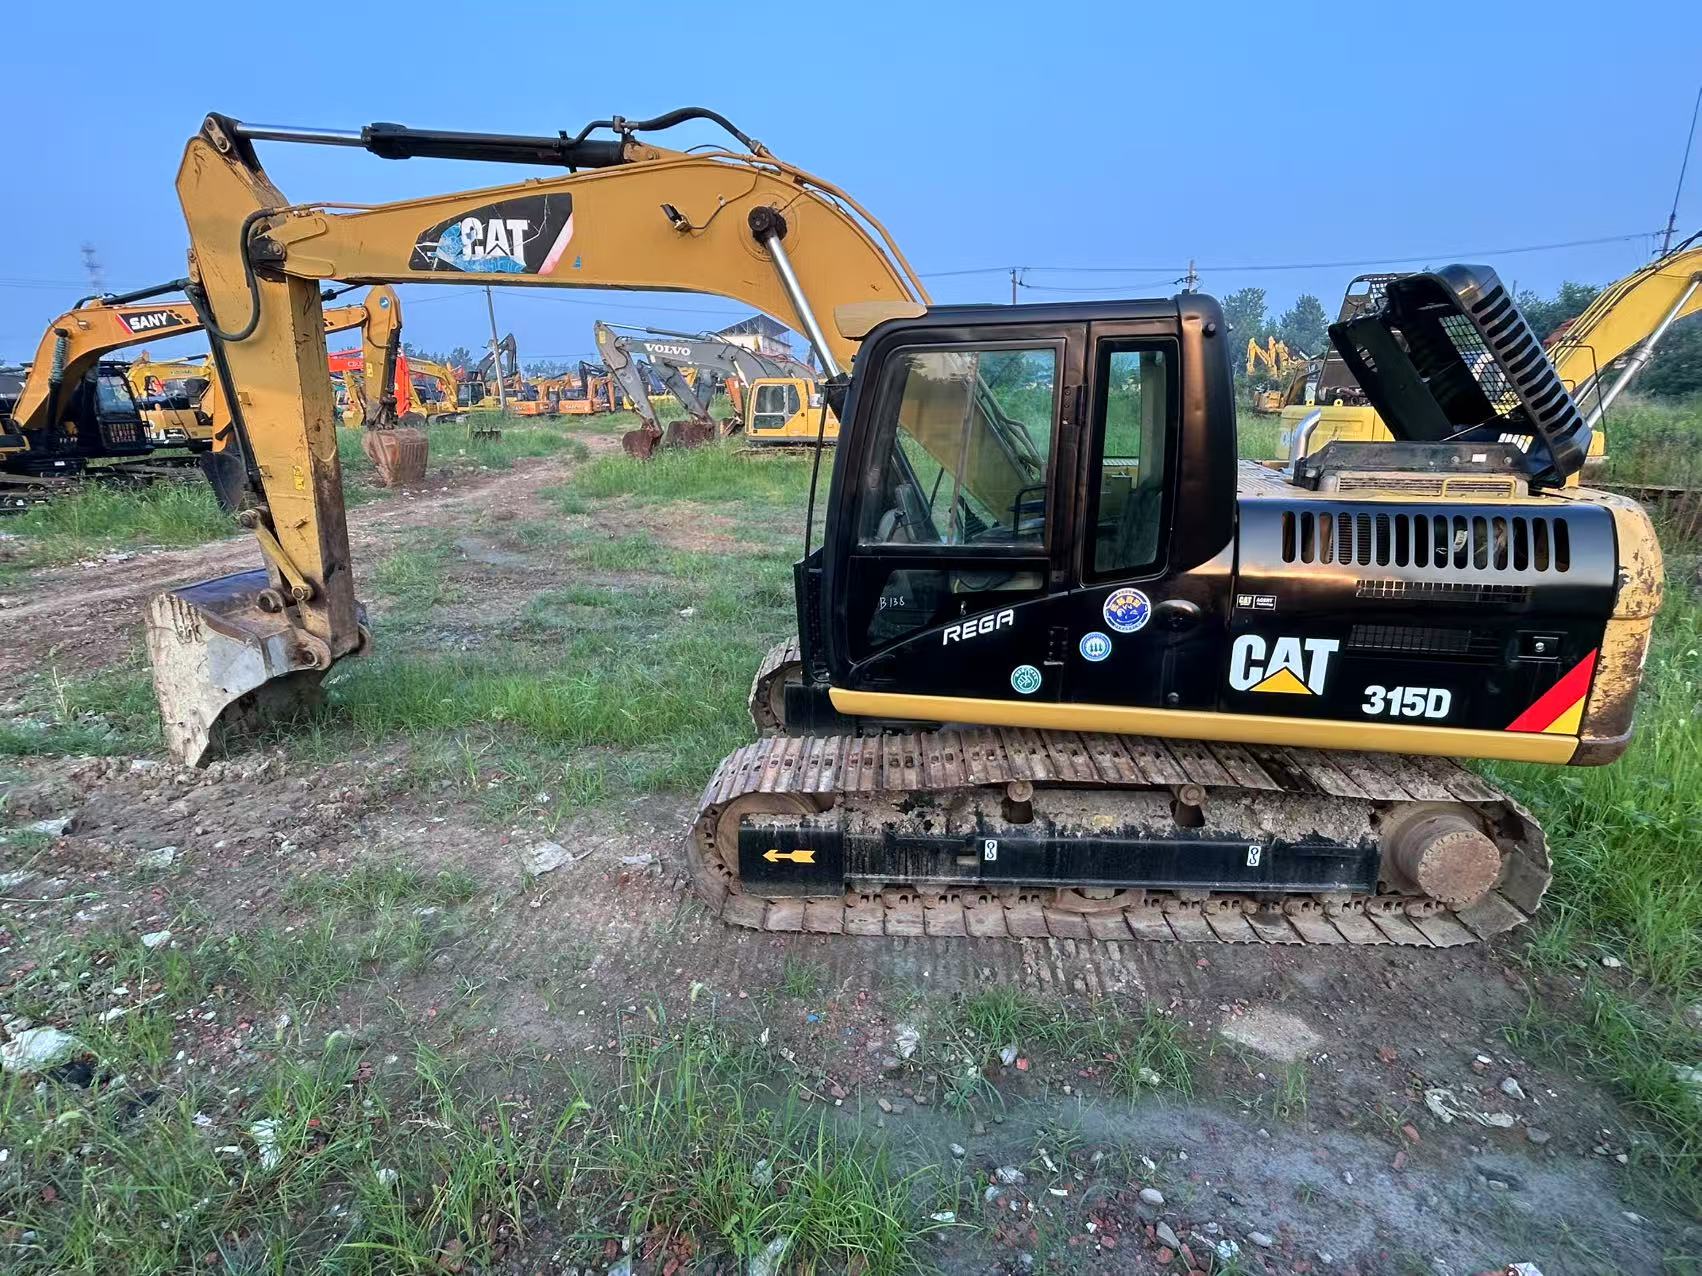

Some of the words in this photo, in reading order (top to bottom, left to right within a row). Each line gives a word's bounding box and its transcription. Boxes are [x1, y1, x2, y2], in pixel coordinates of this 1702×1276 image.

[461, 216, 530, 266] CAT
[129, 312, 167, 330] SANY
[643, 343, 691, 356] VOLVO
[942, 608, 1014, 646] REGA
[1229, 634, 1340, 696] CAT
[1361, 685, 1452, 719] 315D
